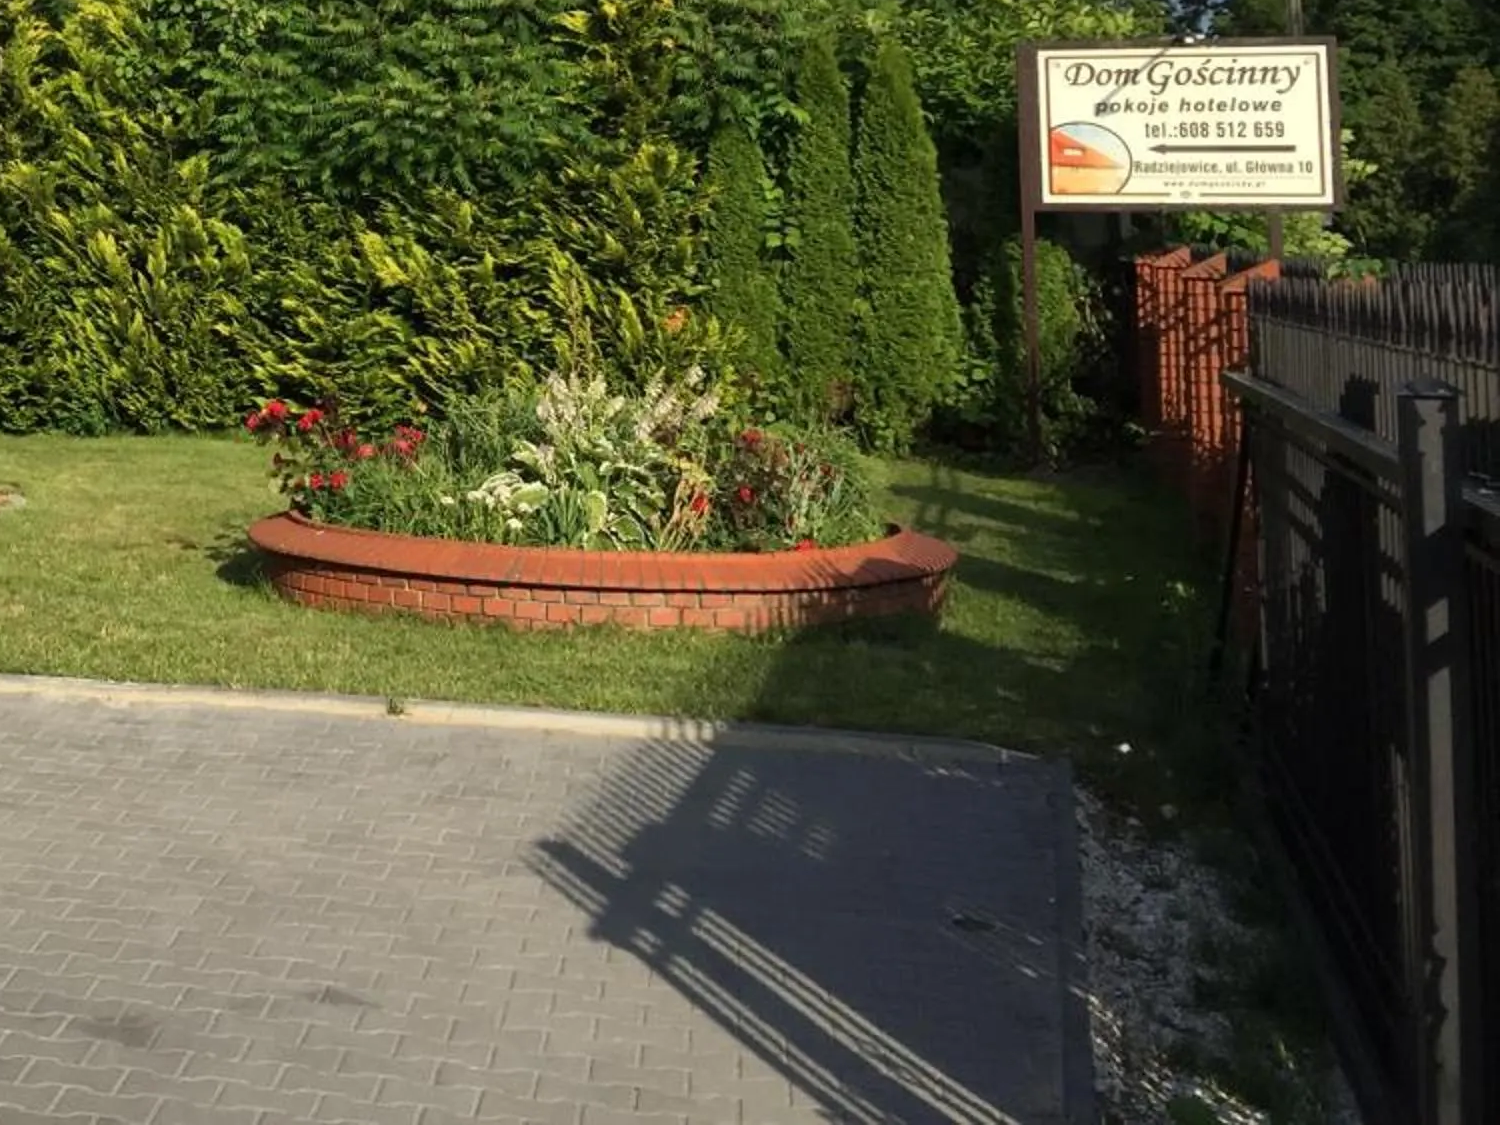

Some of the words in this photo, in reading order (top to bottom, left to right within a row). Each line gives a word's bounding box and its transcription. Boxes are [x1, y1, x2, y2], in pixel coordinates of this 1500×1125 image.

[1064, 61, 1141, 87] Dom
[1146, 58, 1301, 96] Gościnny
[1095, 98, 1170, 117] pokoje
[1179, 96, 1284, 114] hotelowe
[1215, 120, 1247, 138] 512
[1253, 120, 1285, 139] 659
[1245, 160, 1295, 174] Główna
[1299, 160, 1313, 174] 10
